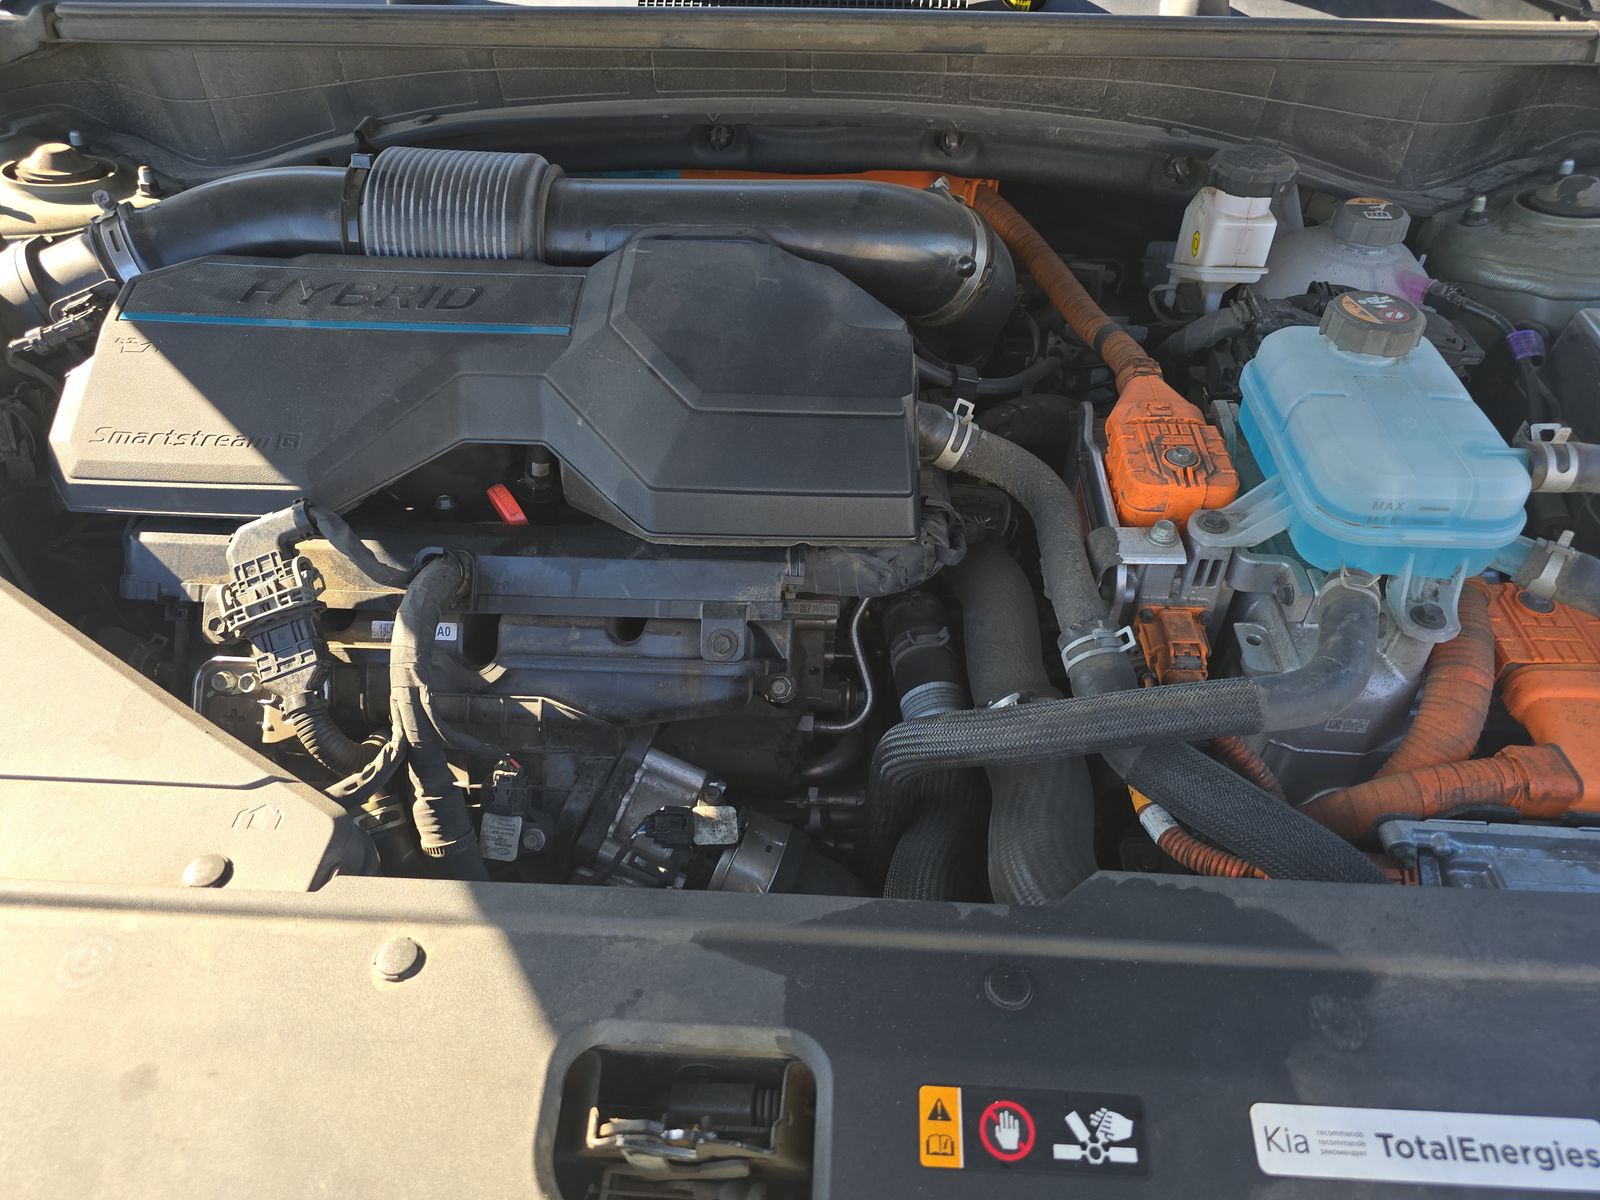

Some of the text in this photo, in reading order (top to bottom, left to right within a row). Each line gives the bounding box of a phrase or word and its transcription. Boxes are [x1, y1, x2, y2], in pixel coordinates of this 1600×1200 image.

[236, 279, 484, 310] HYBRID
[88, 426, 273, 449] Smartstream
[1372, 501, 1405, 511] MAX
[1263, 1125, 1310, 1154] Kia
[1375, 1132, 1600, 1171] TotalEnergies
